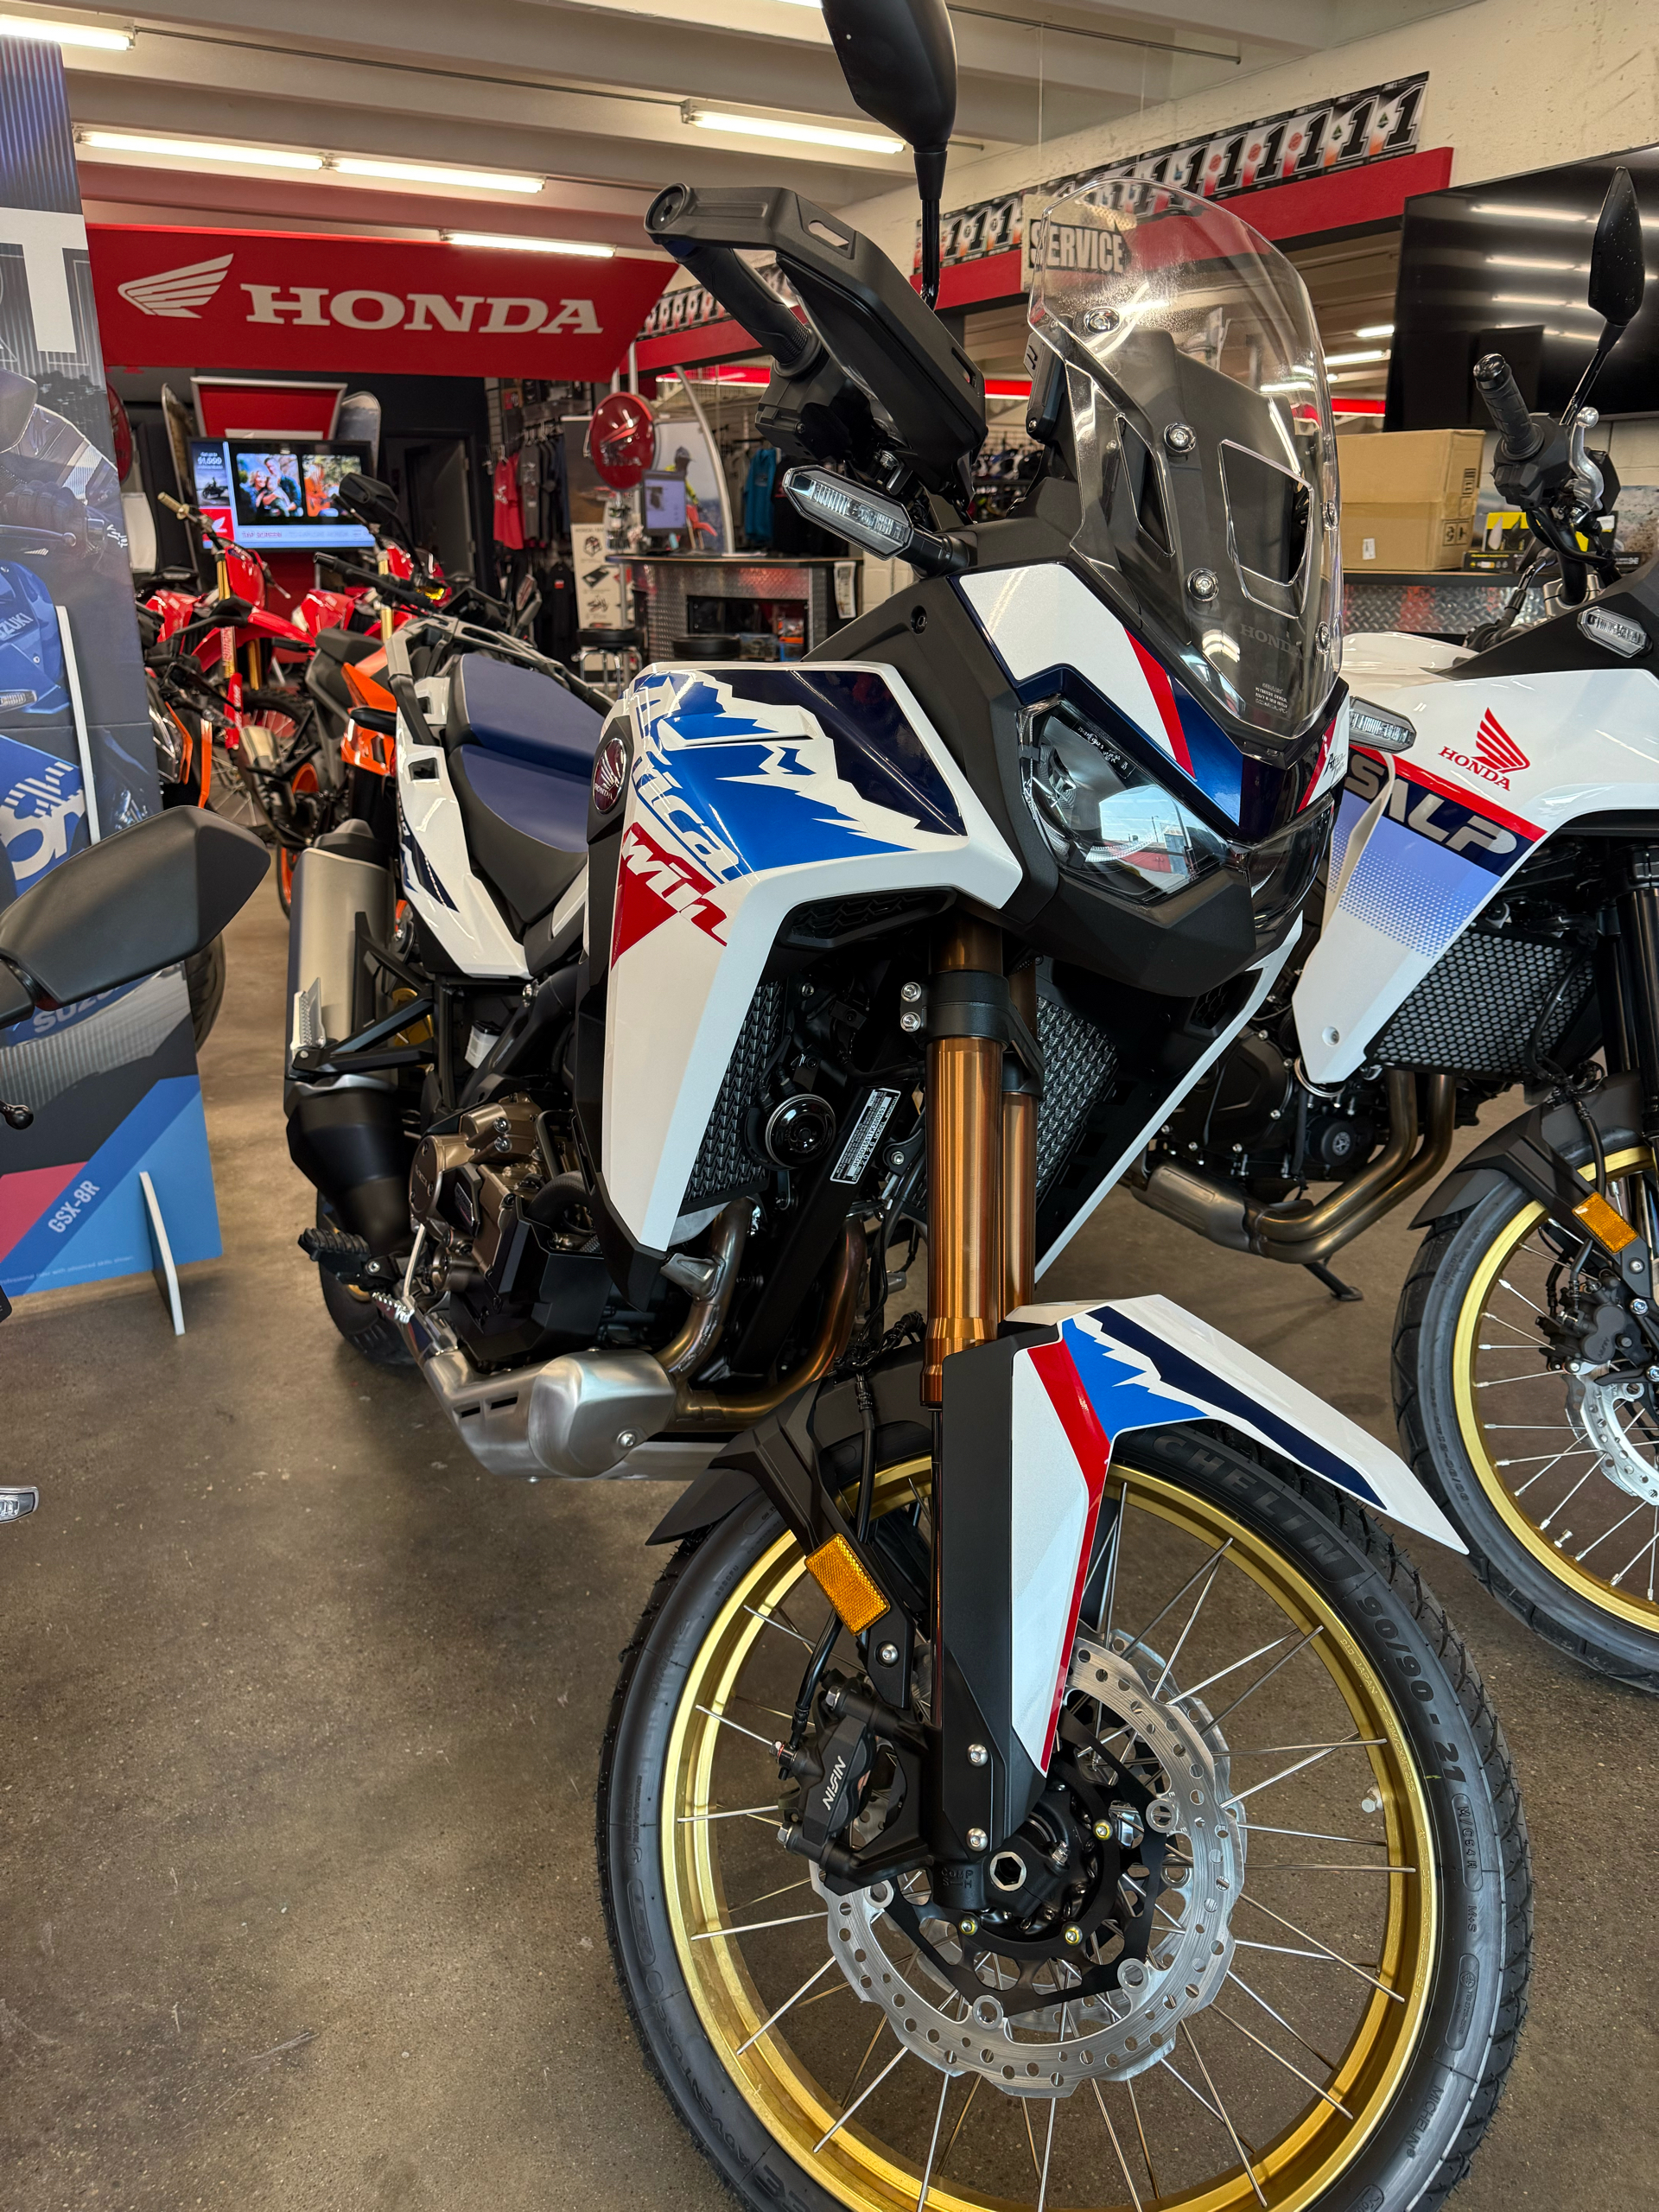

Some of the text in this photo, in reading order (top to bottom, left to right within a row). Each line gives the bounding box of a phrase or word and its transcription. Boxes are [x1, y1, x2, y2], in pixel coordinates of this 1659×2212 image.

[1030, 221, 1123, 273] SERVICE
[240, 283, 603, 334] HONDA
[0, 612, 34, 639] ZUKI
[1438, 746, 1511, 791] HONDA
[48, 1179, 101, 1234] GSX-8R
[1153, 1434, 1346, 1567] CHELIN
[1354, 1661, 1378, 1694] JAPAN
[1356, 1595, 1435, 1702] 90/90
[1433, 1740, 1467, 1783] 21
